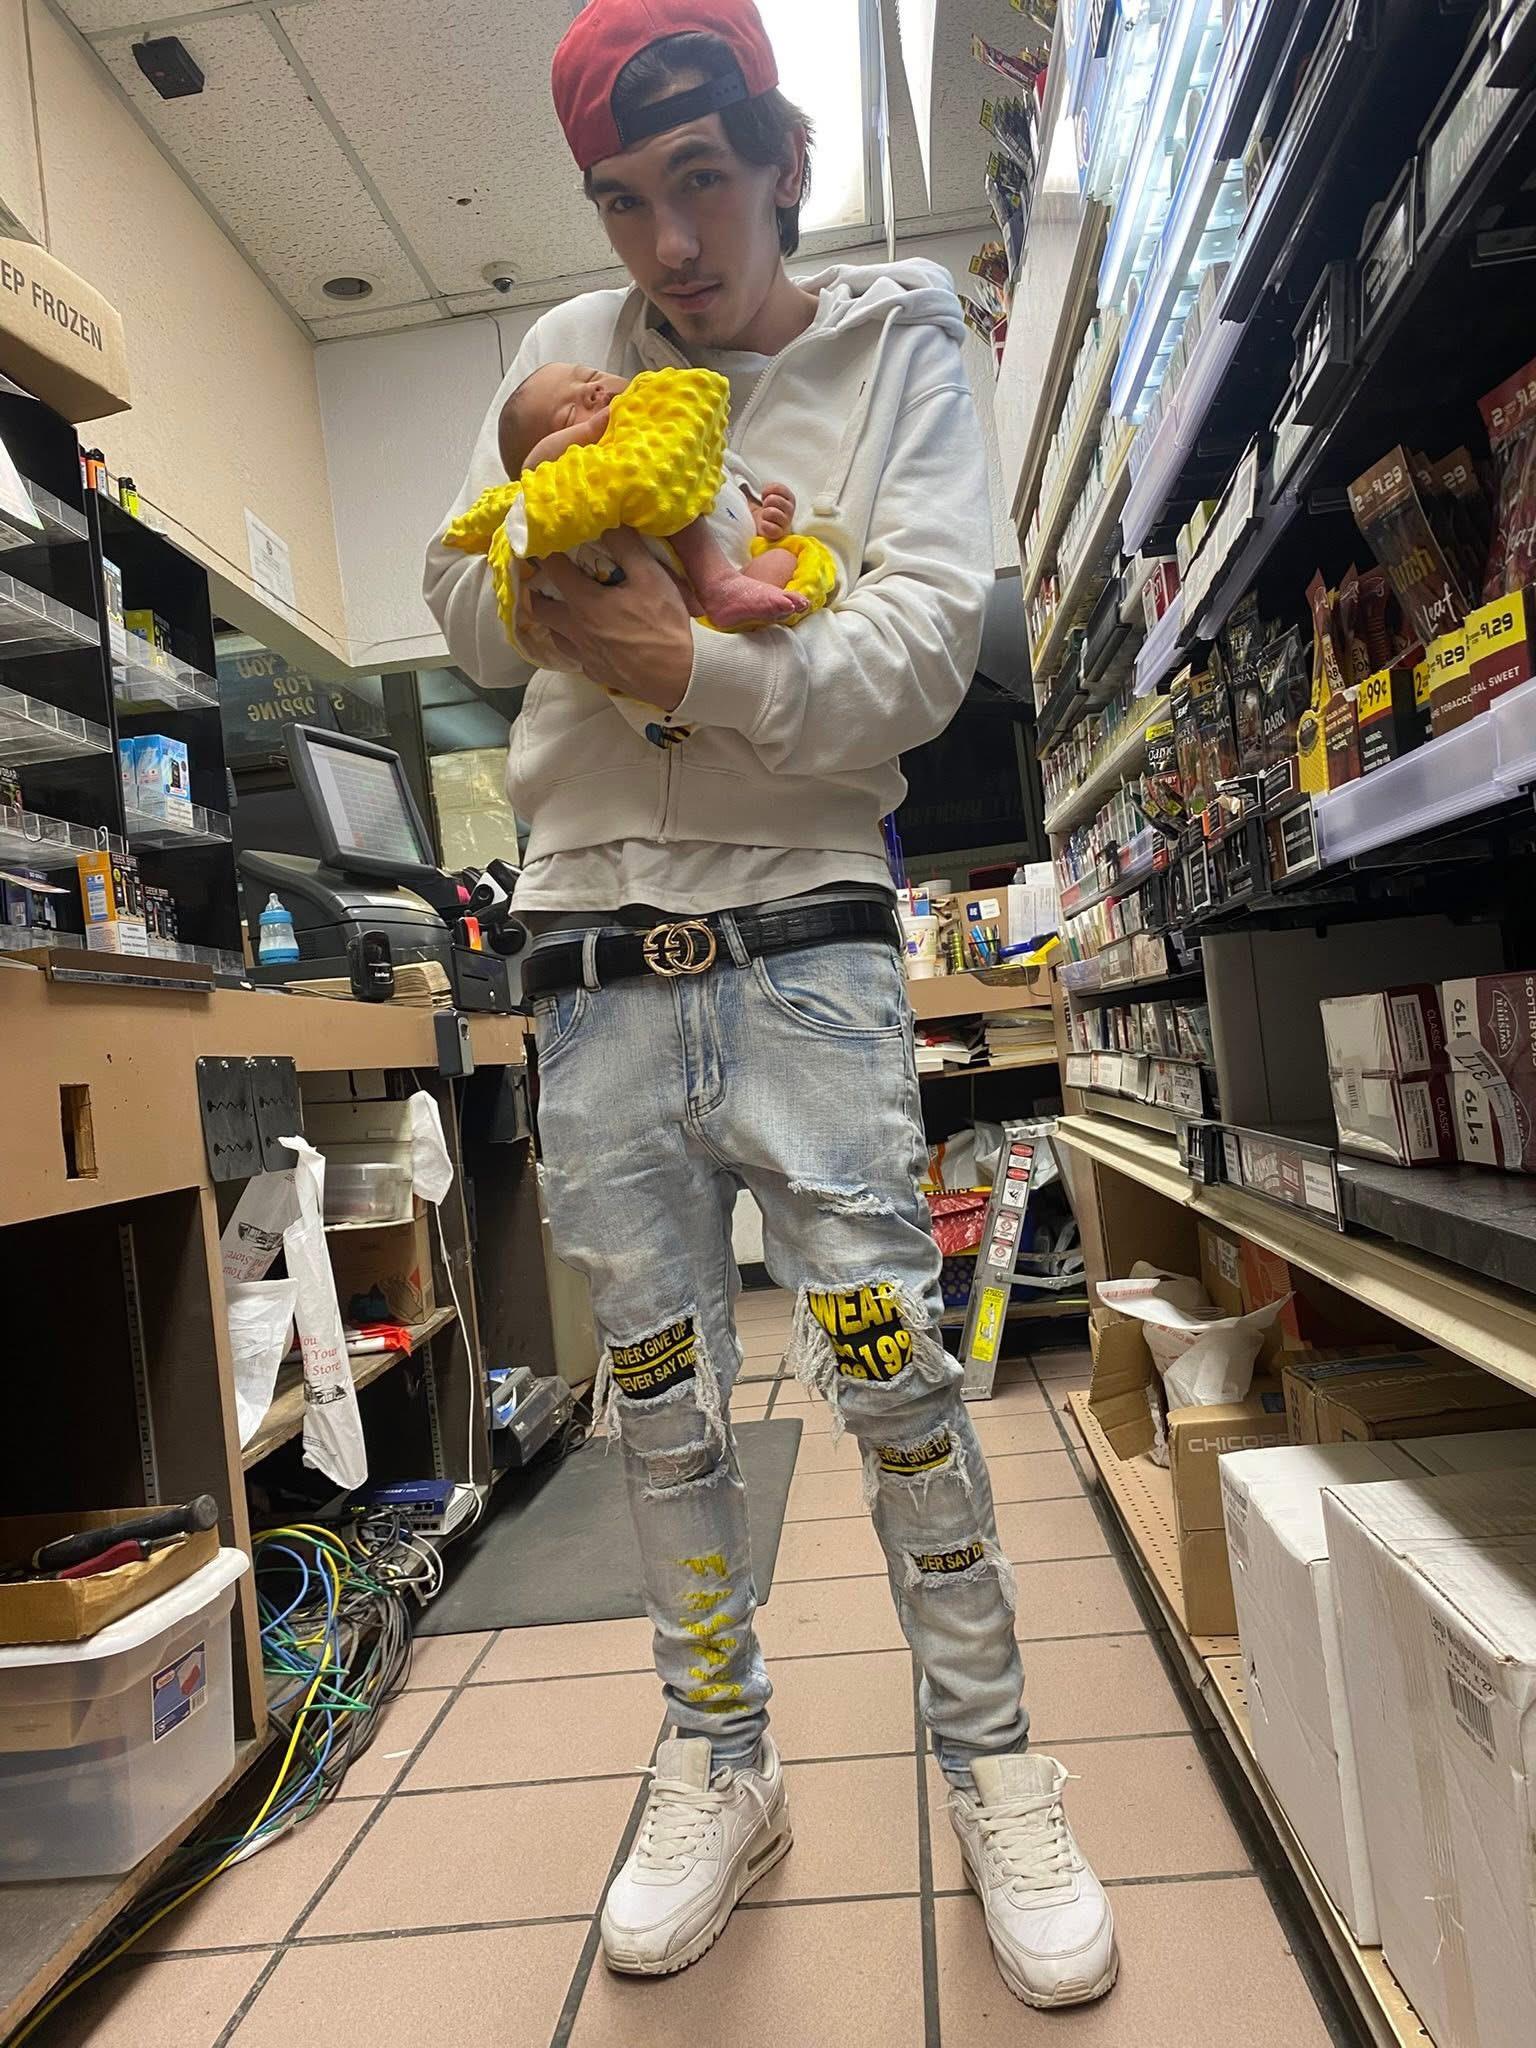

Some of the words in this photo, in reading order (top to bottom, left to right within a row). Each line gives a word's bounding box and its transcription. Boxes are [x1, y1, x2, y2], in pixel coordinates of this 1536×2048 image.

[31, 280, 103, 352] FROZEN
[1488, 666, 1521, 688] SWEET
[1263, 707, 1287, 736] DARK
[644, 1330, 673, 1358] GIVE
[672, 1320, 687, 1341] UP
[654, 1357, 678, 1382] SAY
[945, 1549, 971, 1570] SAY
